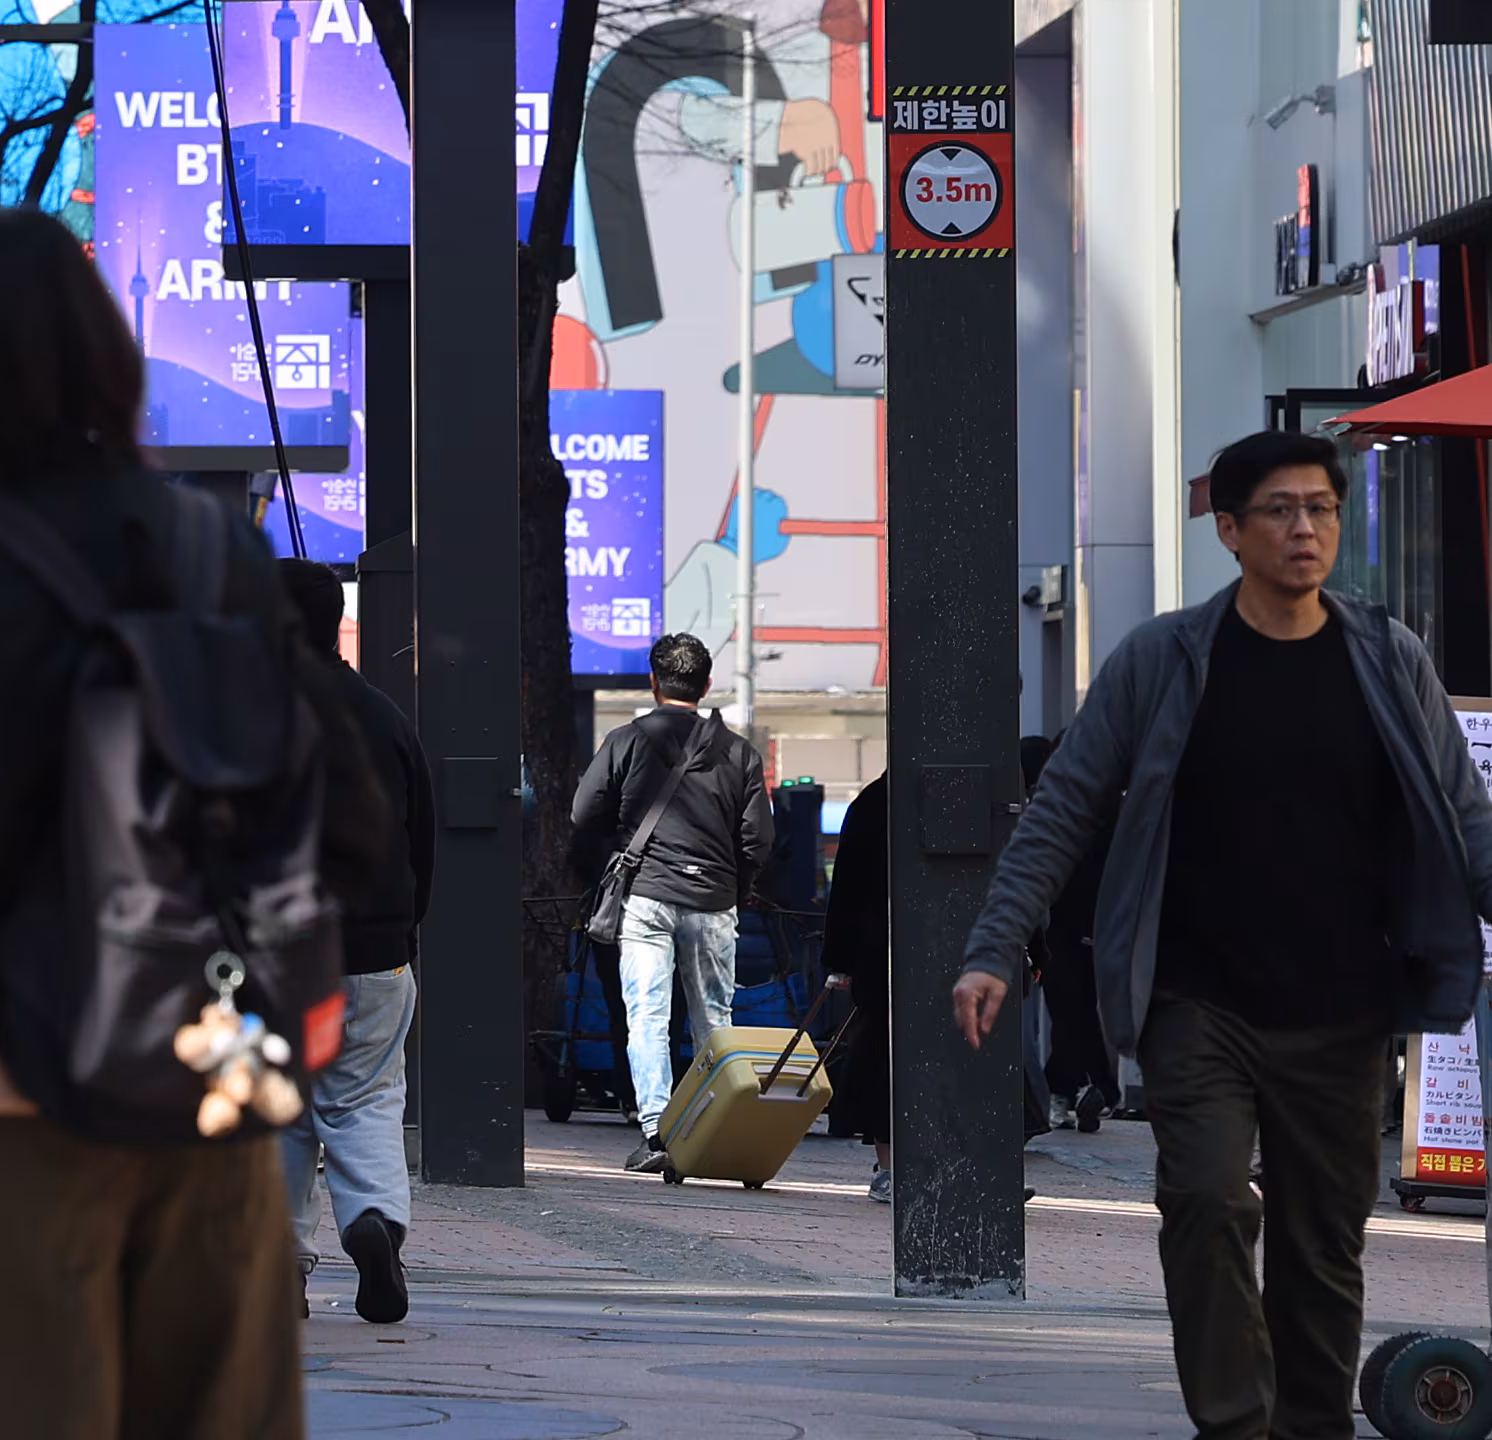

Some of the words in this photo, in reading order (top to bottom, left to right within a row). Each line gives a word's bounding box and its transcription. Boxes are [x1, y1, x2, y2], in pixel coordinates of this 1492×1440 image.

[114, 91, 222, 128] WELC
[893, 100, 1007, 130] 제한높이
[916, 176, 993, 203] 3.5m
[550, 433, 650, 462] LCOME
[565, 468, 609, 500] TS
[565, 506, 590, 538] &
[564, 545, 632, 577] RMY
[1420, 1153, 1447, 1171] 직접
[1448, 1155, 1475, 1173] 뽑은
